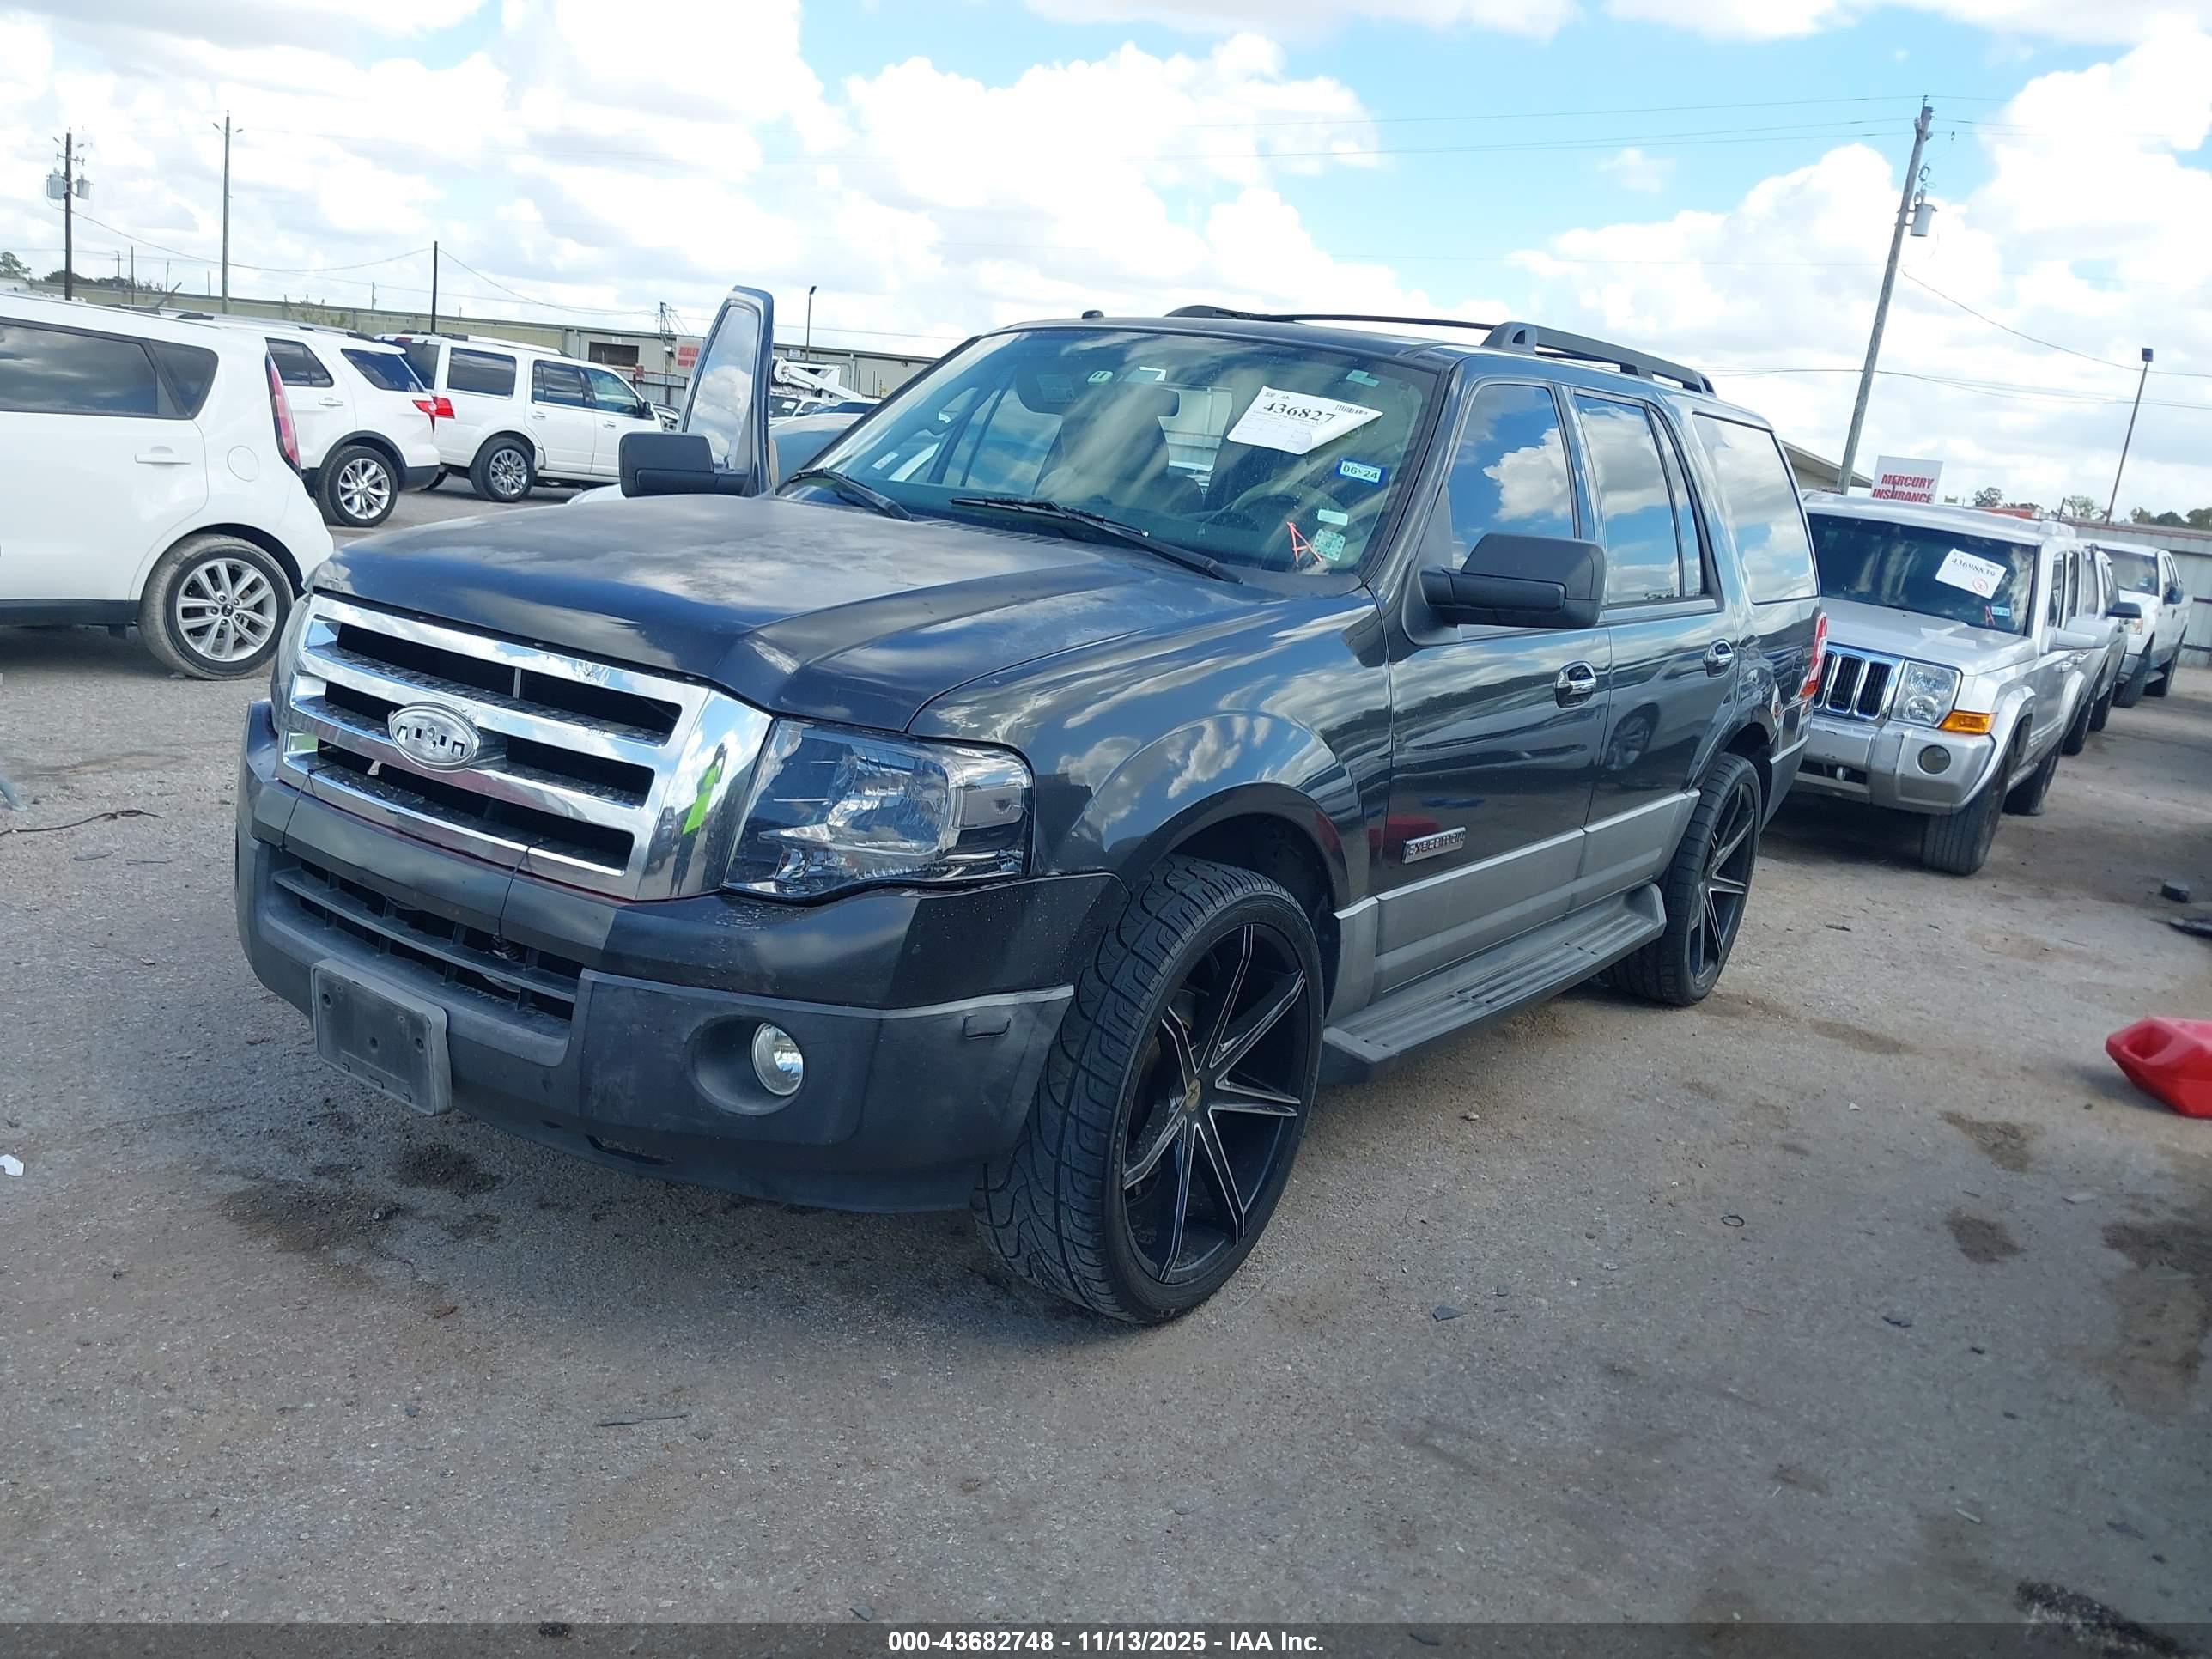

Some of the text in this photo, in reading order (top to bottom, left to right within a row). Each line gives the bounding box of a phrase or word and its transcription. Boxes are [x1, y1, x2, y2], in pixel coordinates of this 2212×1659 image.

[1263, 402, 1336, 423] 436827
[1881, 474, 1935, 489] MERCURY
[1872, 489, 1934, 504] INSURANCE
